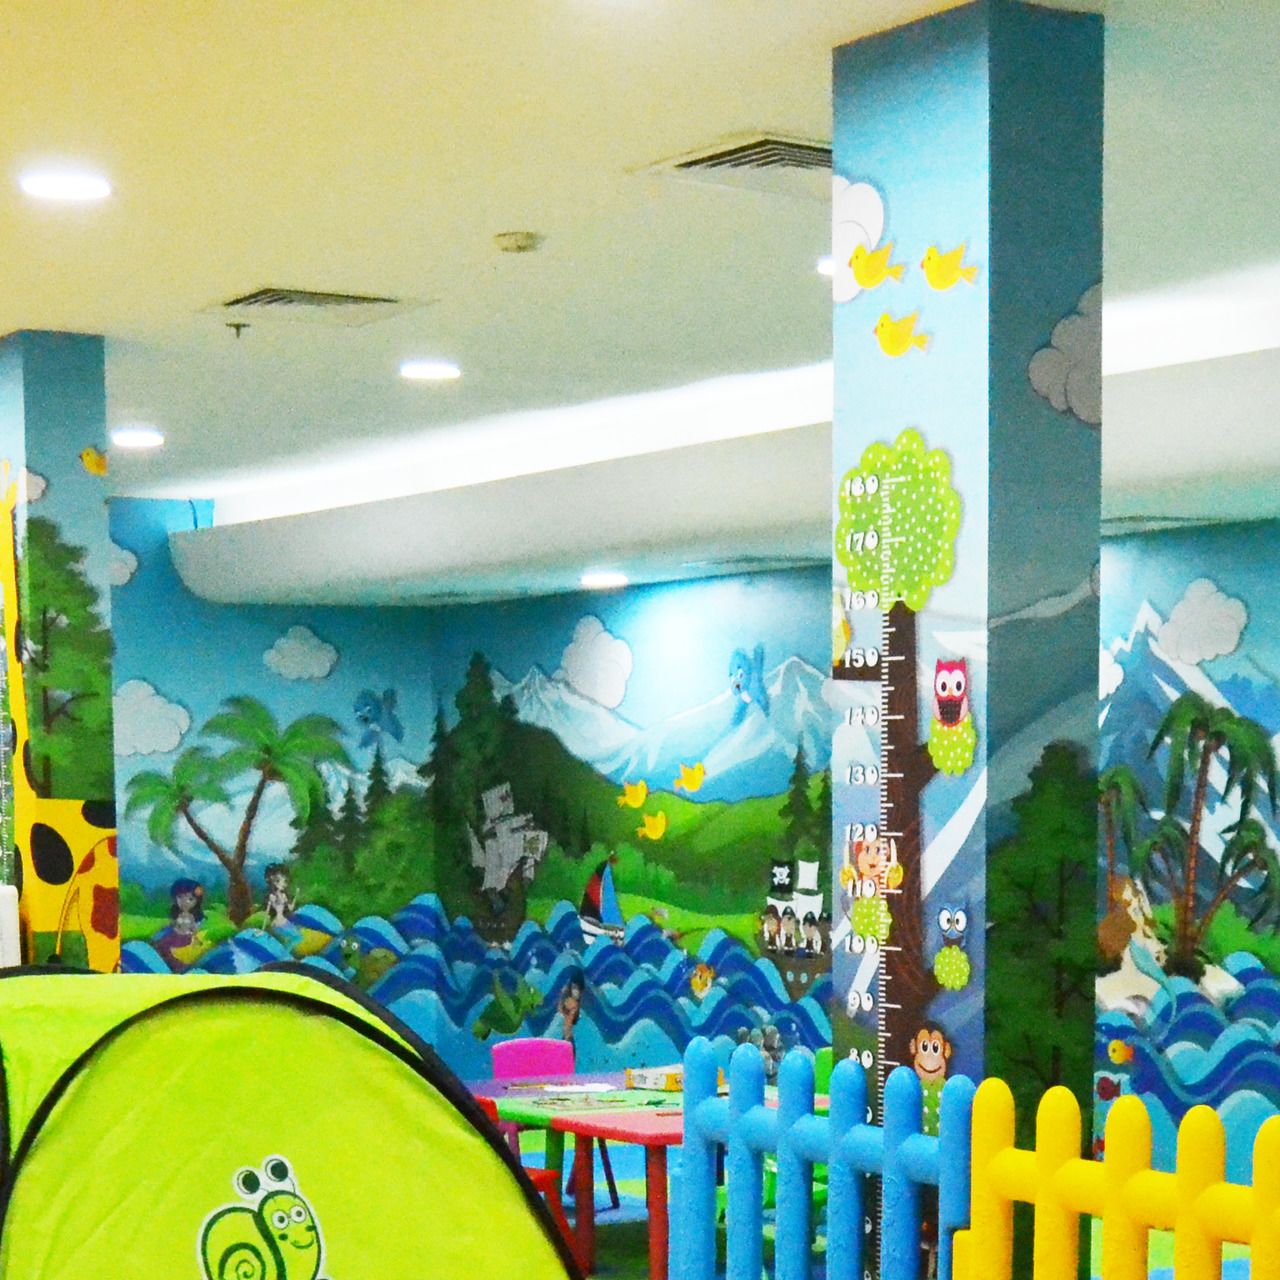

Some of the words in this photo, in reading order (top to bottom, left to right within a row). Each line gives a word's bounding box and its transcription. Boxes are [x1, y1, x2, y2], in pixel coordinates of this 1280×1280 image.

[846, 531, 878, 551] 170
[844, 590, 878, 611] 160
[845, 648, 878, 668] 150
[845, 706, 879, 726] 140
[846, 765, 879, 785] 130
[846, 823, 878, 842] 120
[847, 879, 876, 898] 110
[845, 934, 878, 954] 100
[848, 991, 873, 1012] 90
